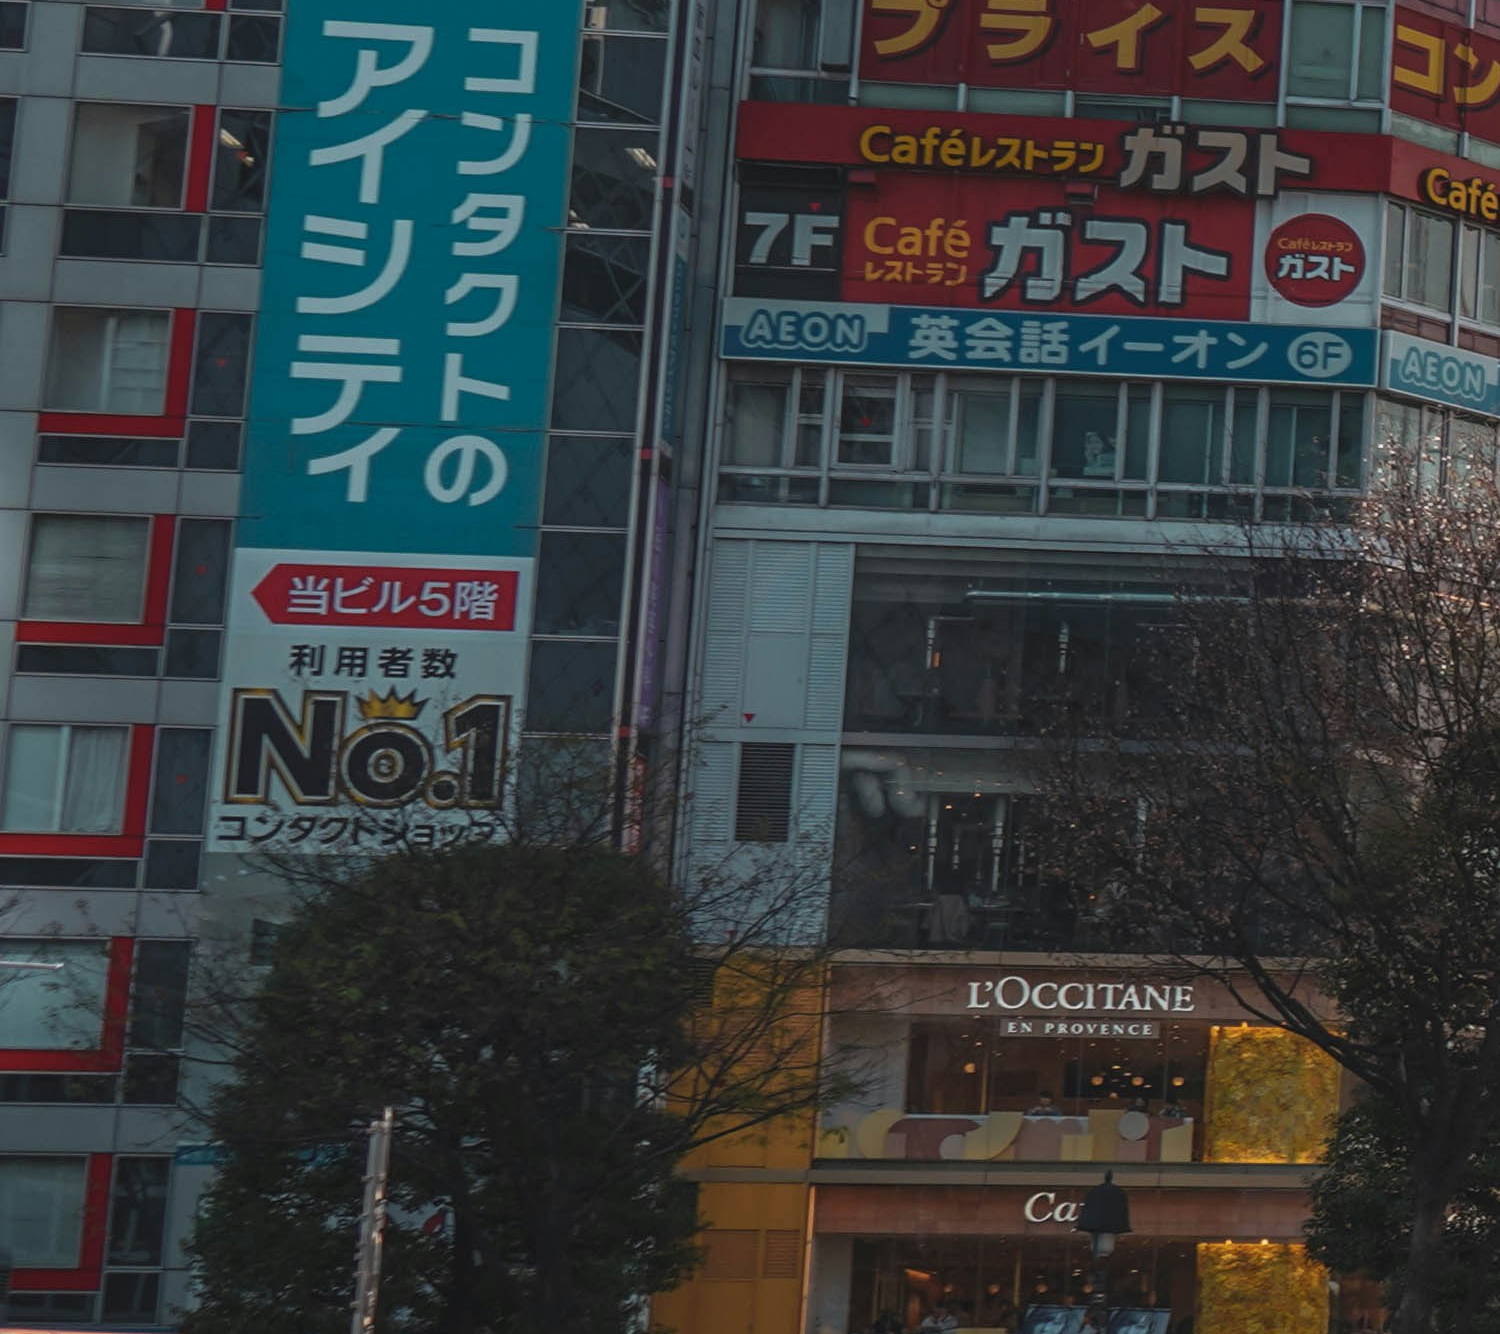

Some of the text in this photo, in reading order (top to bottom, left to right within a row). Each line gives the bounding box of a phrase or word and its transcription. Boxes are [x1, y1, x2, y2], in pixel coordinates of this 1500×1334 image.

[1119, 122, 1312, 197] ガスト
[745, 210, 841, 266] 7F
[864, 215, 971, 257] Café
[289, 20, 434, 503] アイシティ
[423, 28, 540, 506] コンタクトの
[865, 259, 968, 286] レストラン
[982, 211, 1229, 304] ガスト
[1277, 254, 1355, 282] ガスト
[748, 314, 864, 348] AEON
[909, 314, 1269, 366] 英会話イーオン
[1300, 338, 1347, 369] 6F
[1402, 347, 1486, 399] AEON
[287, 577, 500, 620] 当ビル5階
[289, 644, 459, 678] 利用者数
[967, 976, 1195, 1012] L'OCCITANE
[1007, 1022, 1154, 1036] EN PROVENCE
[1024, 1192, 1084, 1223] Ca
